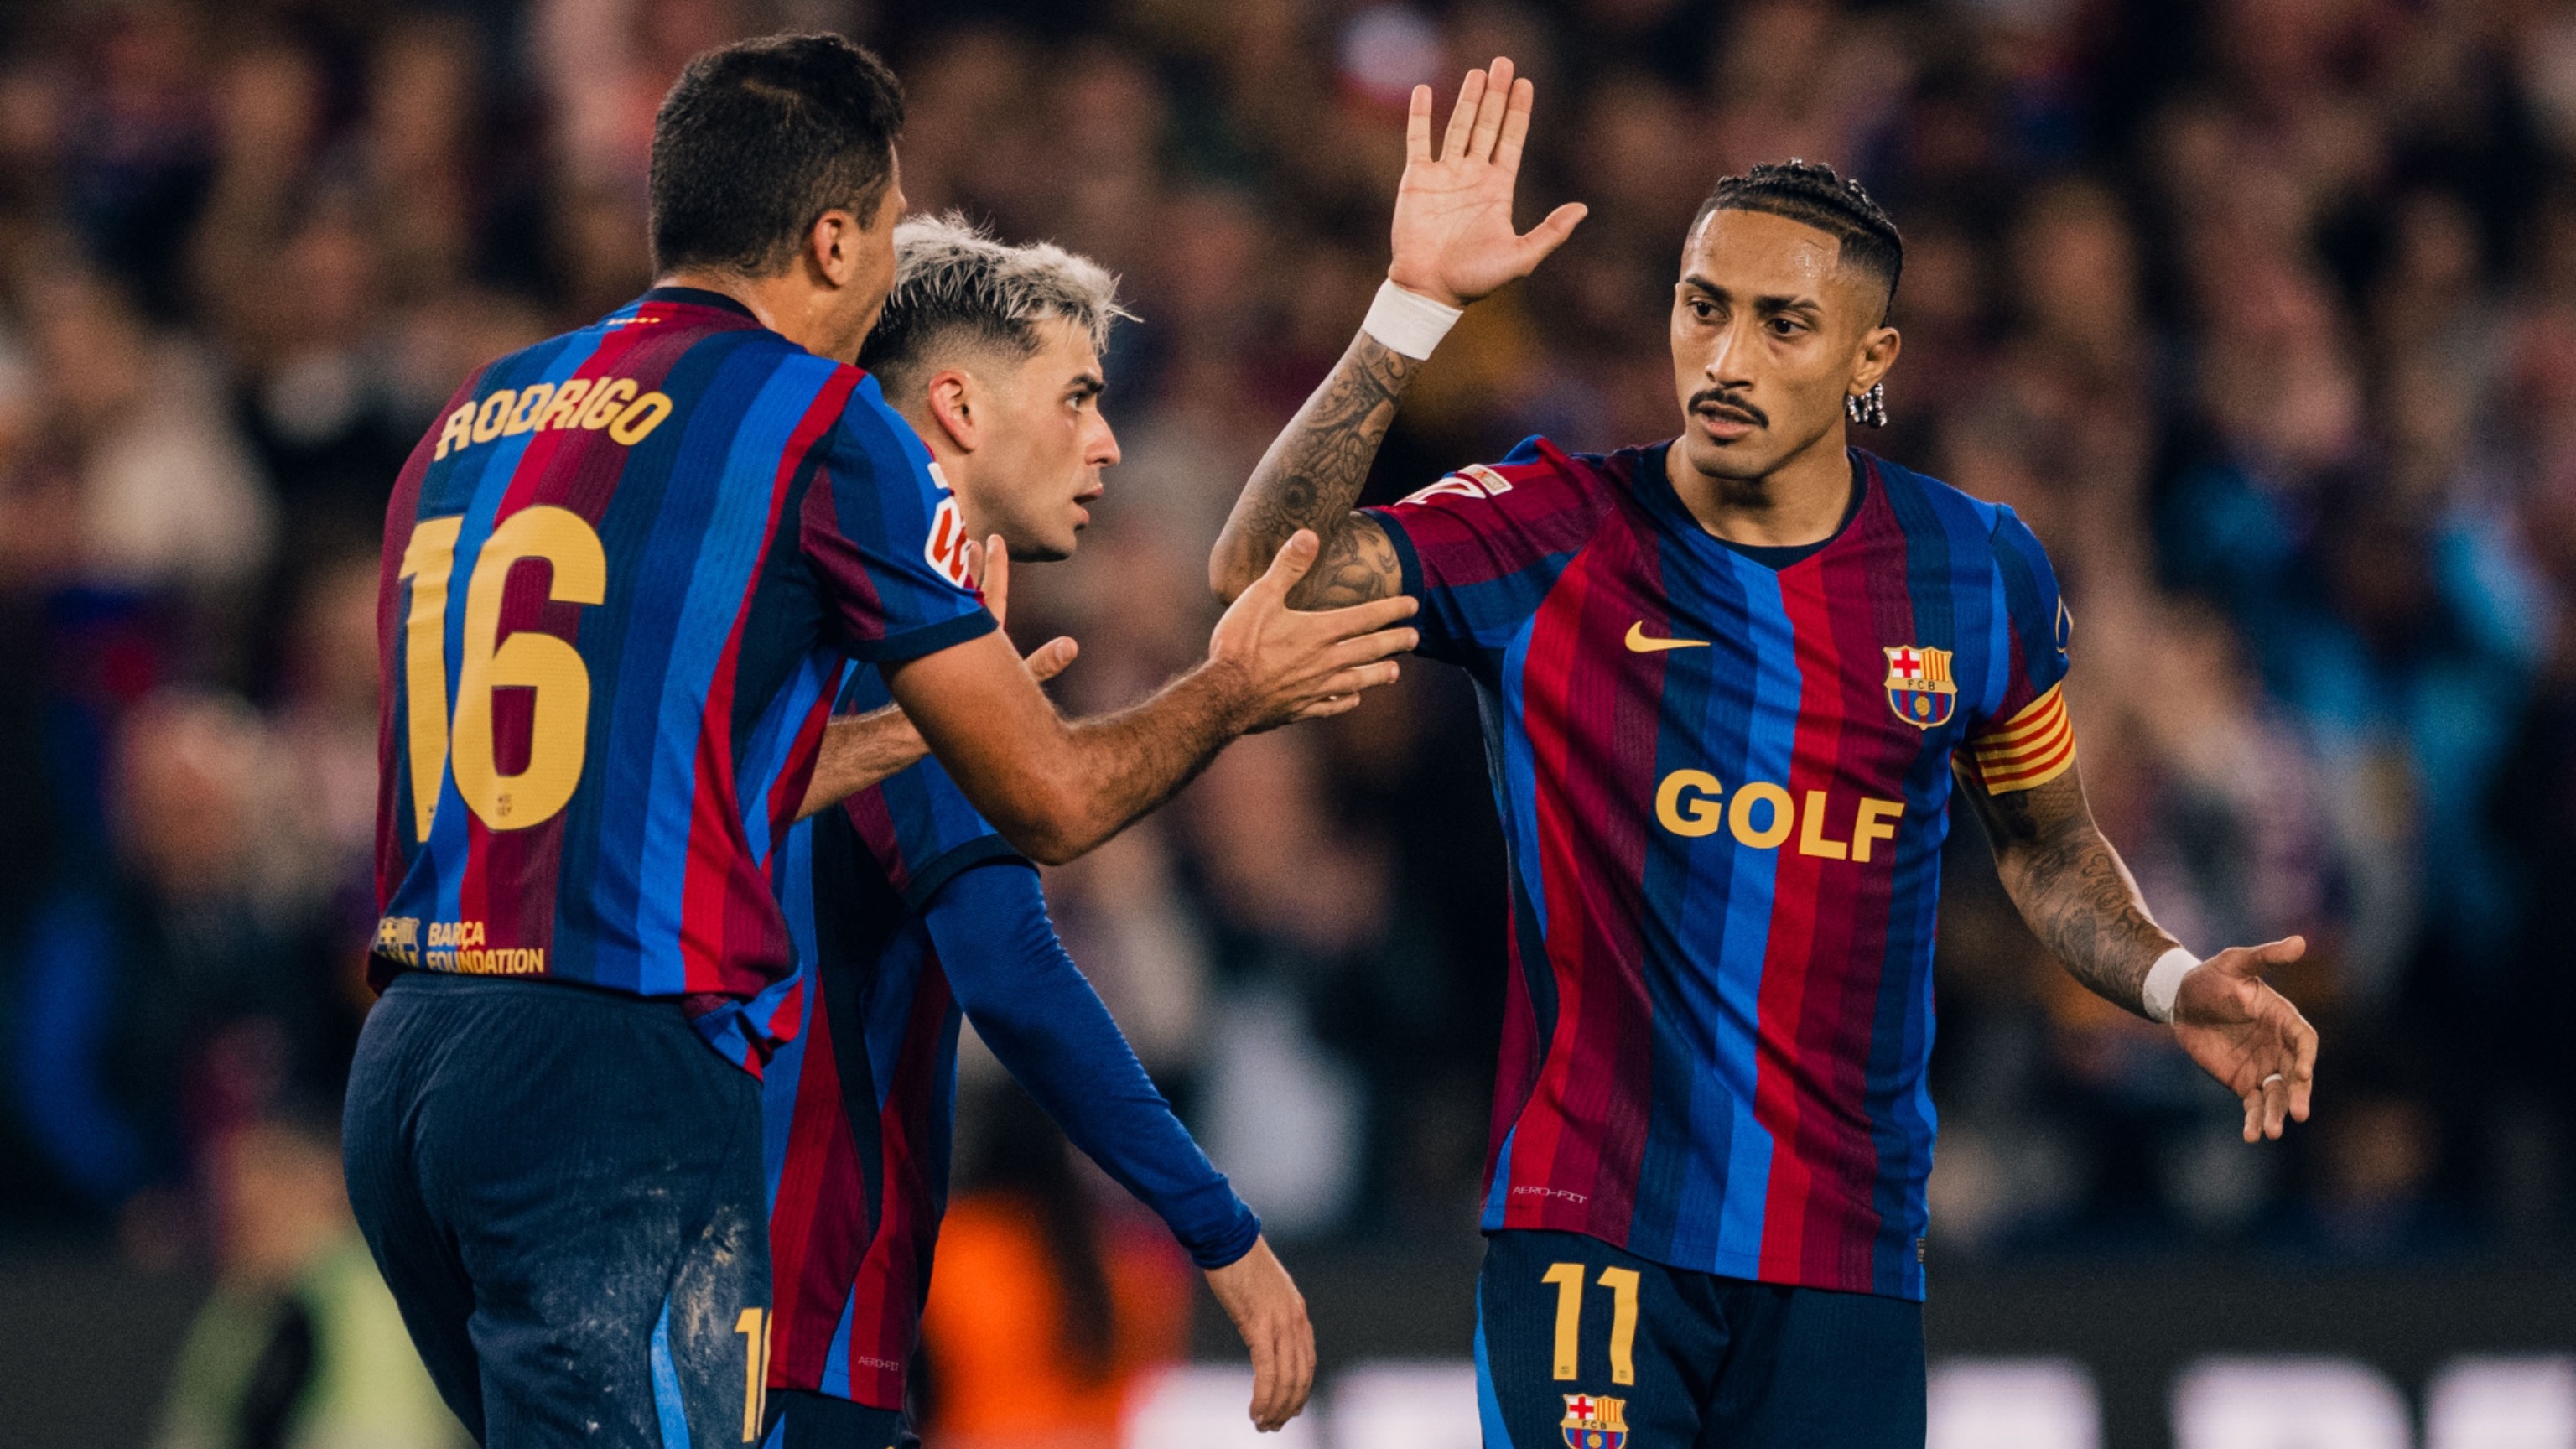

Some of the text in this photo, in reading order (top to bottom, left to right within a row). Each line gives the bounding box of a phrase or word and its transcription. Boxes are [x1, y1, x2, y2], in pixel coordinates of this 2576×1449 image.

[434, 376, 673, 461] RODRIGO
[398, 504, 607, 843] 16
[1907, 679, 1936, 691] FCB
[1655, 769, 1905, 862] GOLF
[426, 948, 545, 974] FOUNDATION
[427, 921, 486, 951] BARÇA
[1512, 1186, 1587, 1204] AERO-FIT
[1541, 1262, 1640, 1386] 11
[735, 1307, 772, 1443] 1
[1581, 1420, 1607, 1430] FCB
